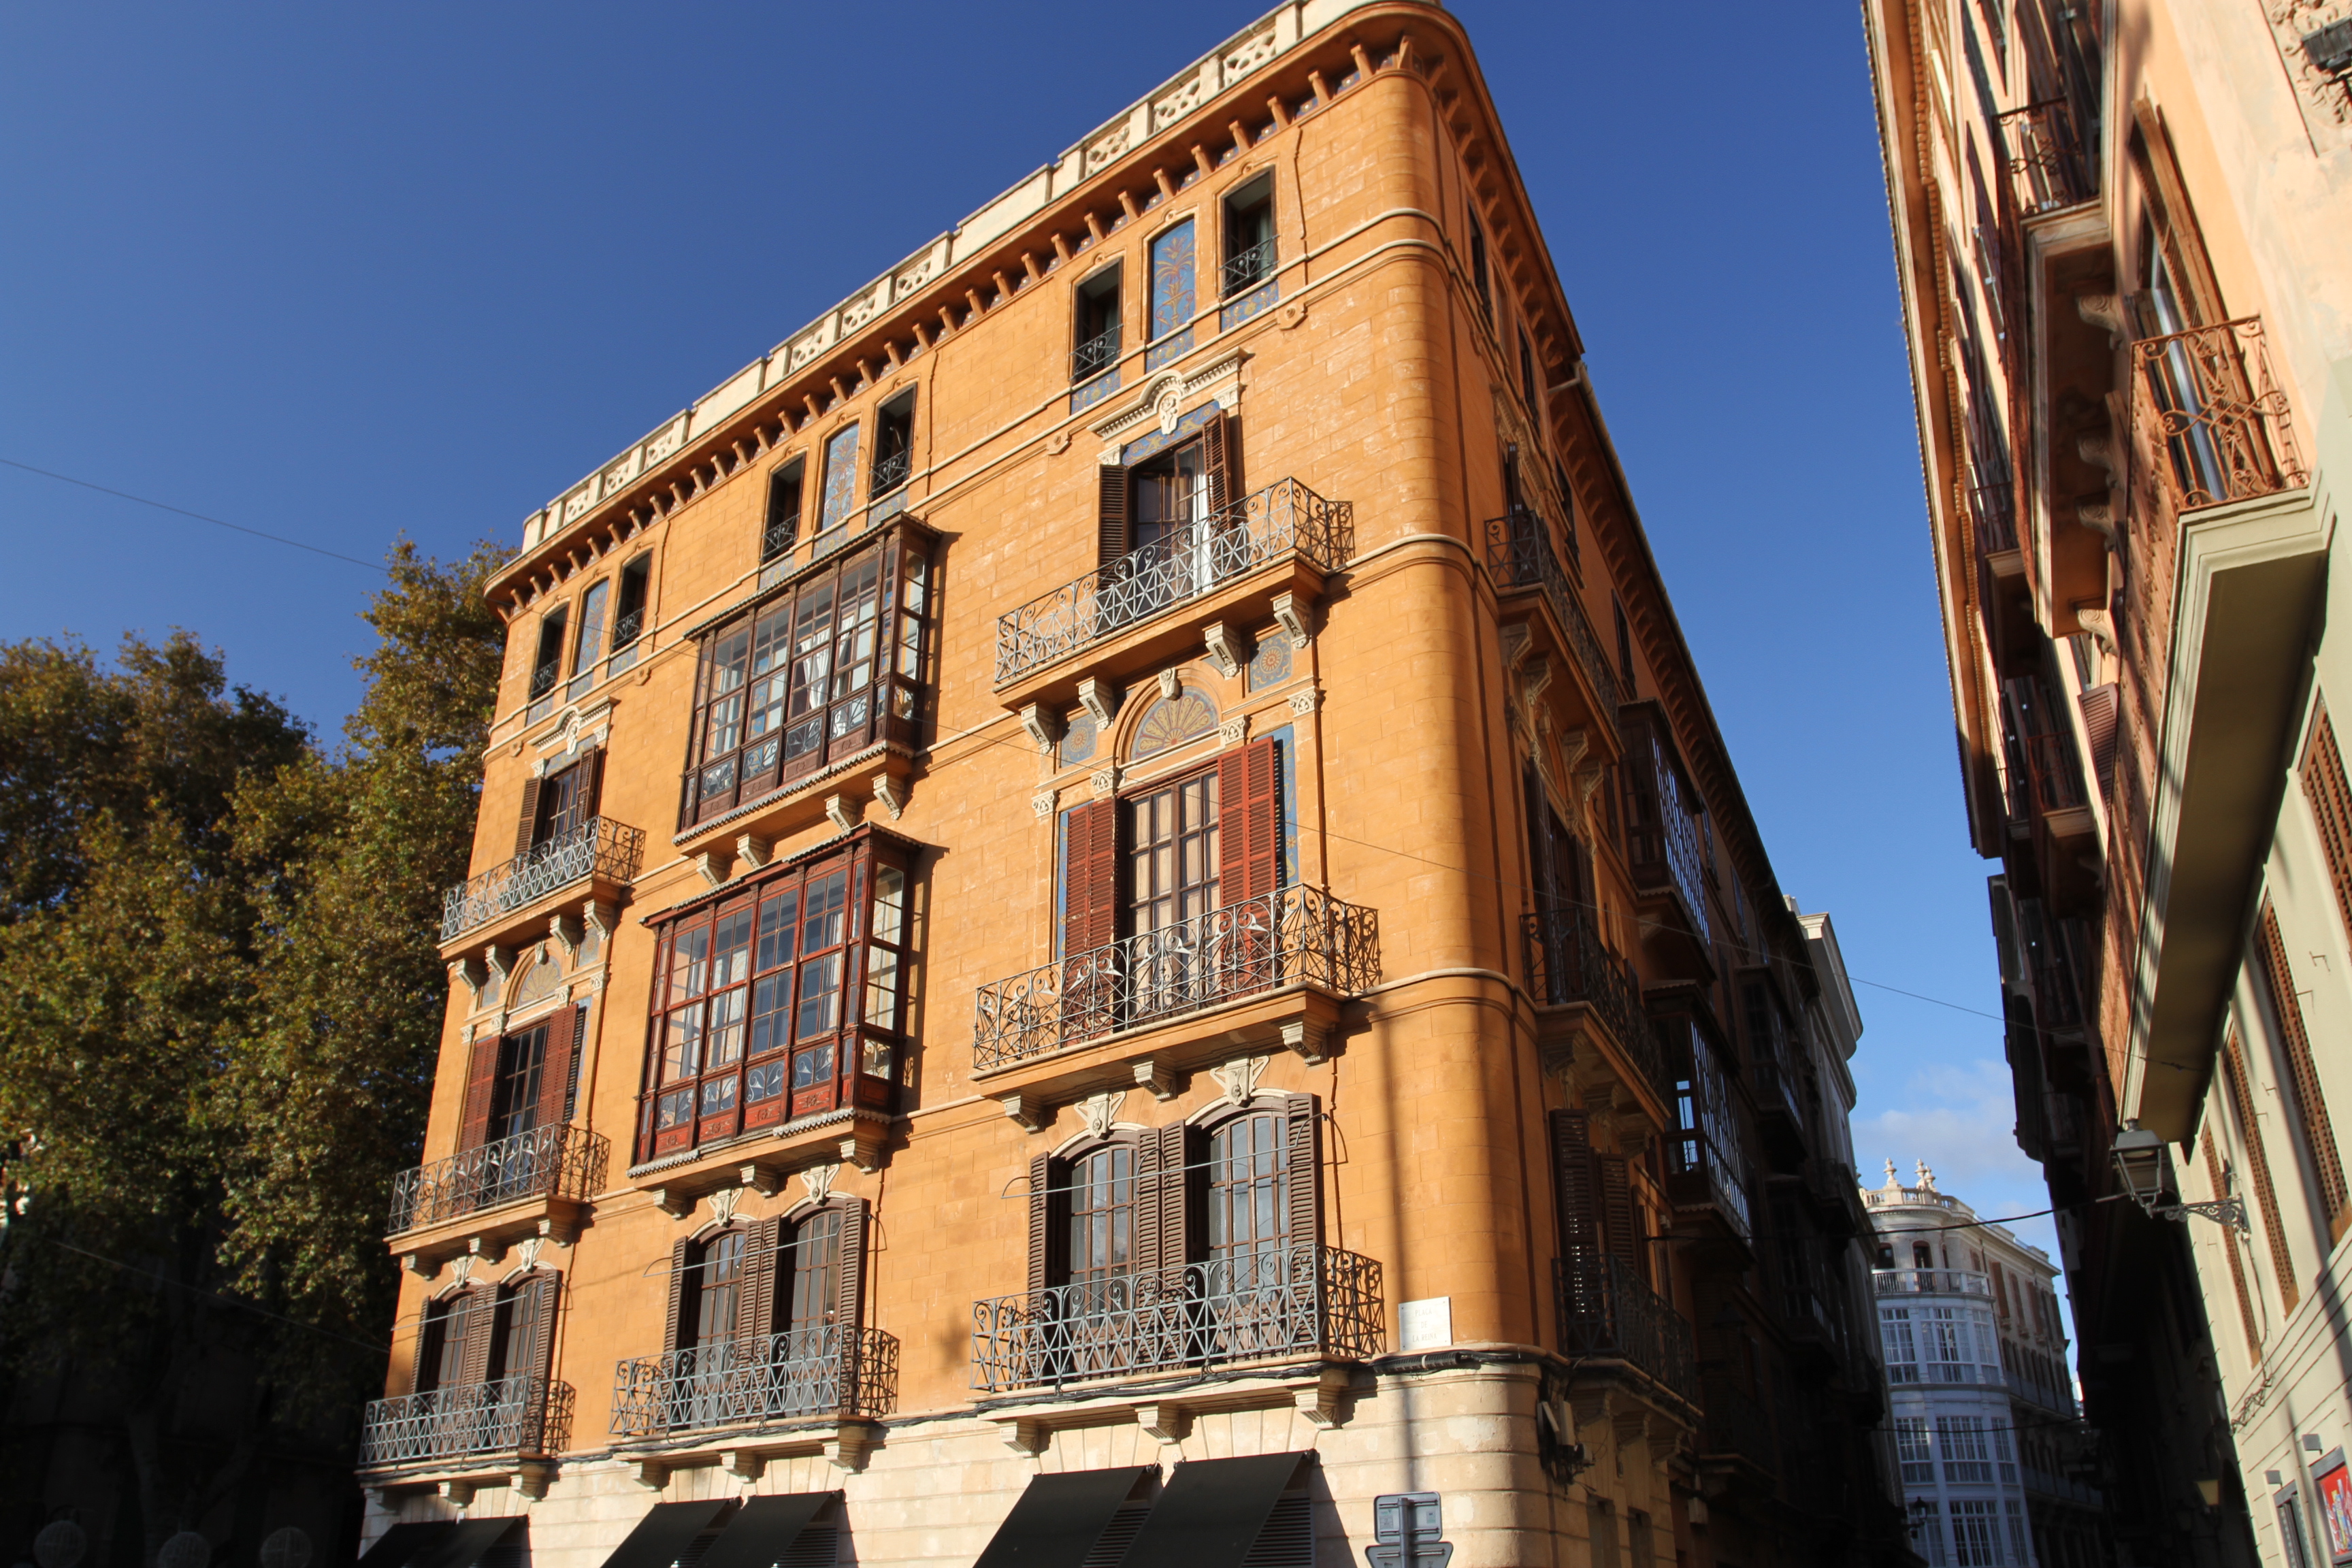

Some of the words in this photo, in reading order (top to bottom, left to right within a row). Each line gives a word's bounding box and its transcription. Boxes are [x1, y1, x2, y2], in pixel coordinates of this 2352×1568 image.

[1421, 1321, 1428, 1329] DE
[1412, 1335, 1420, 1343] LA
[1421, 1333, 1437, 1341] REINA
